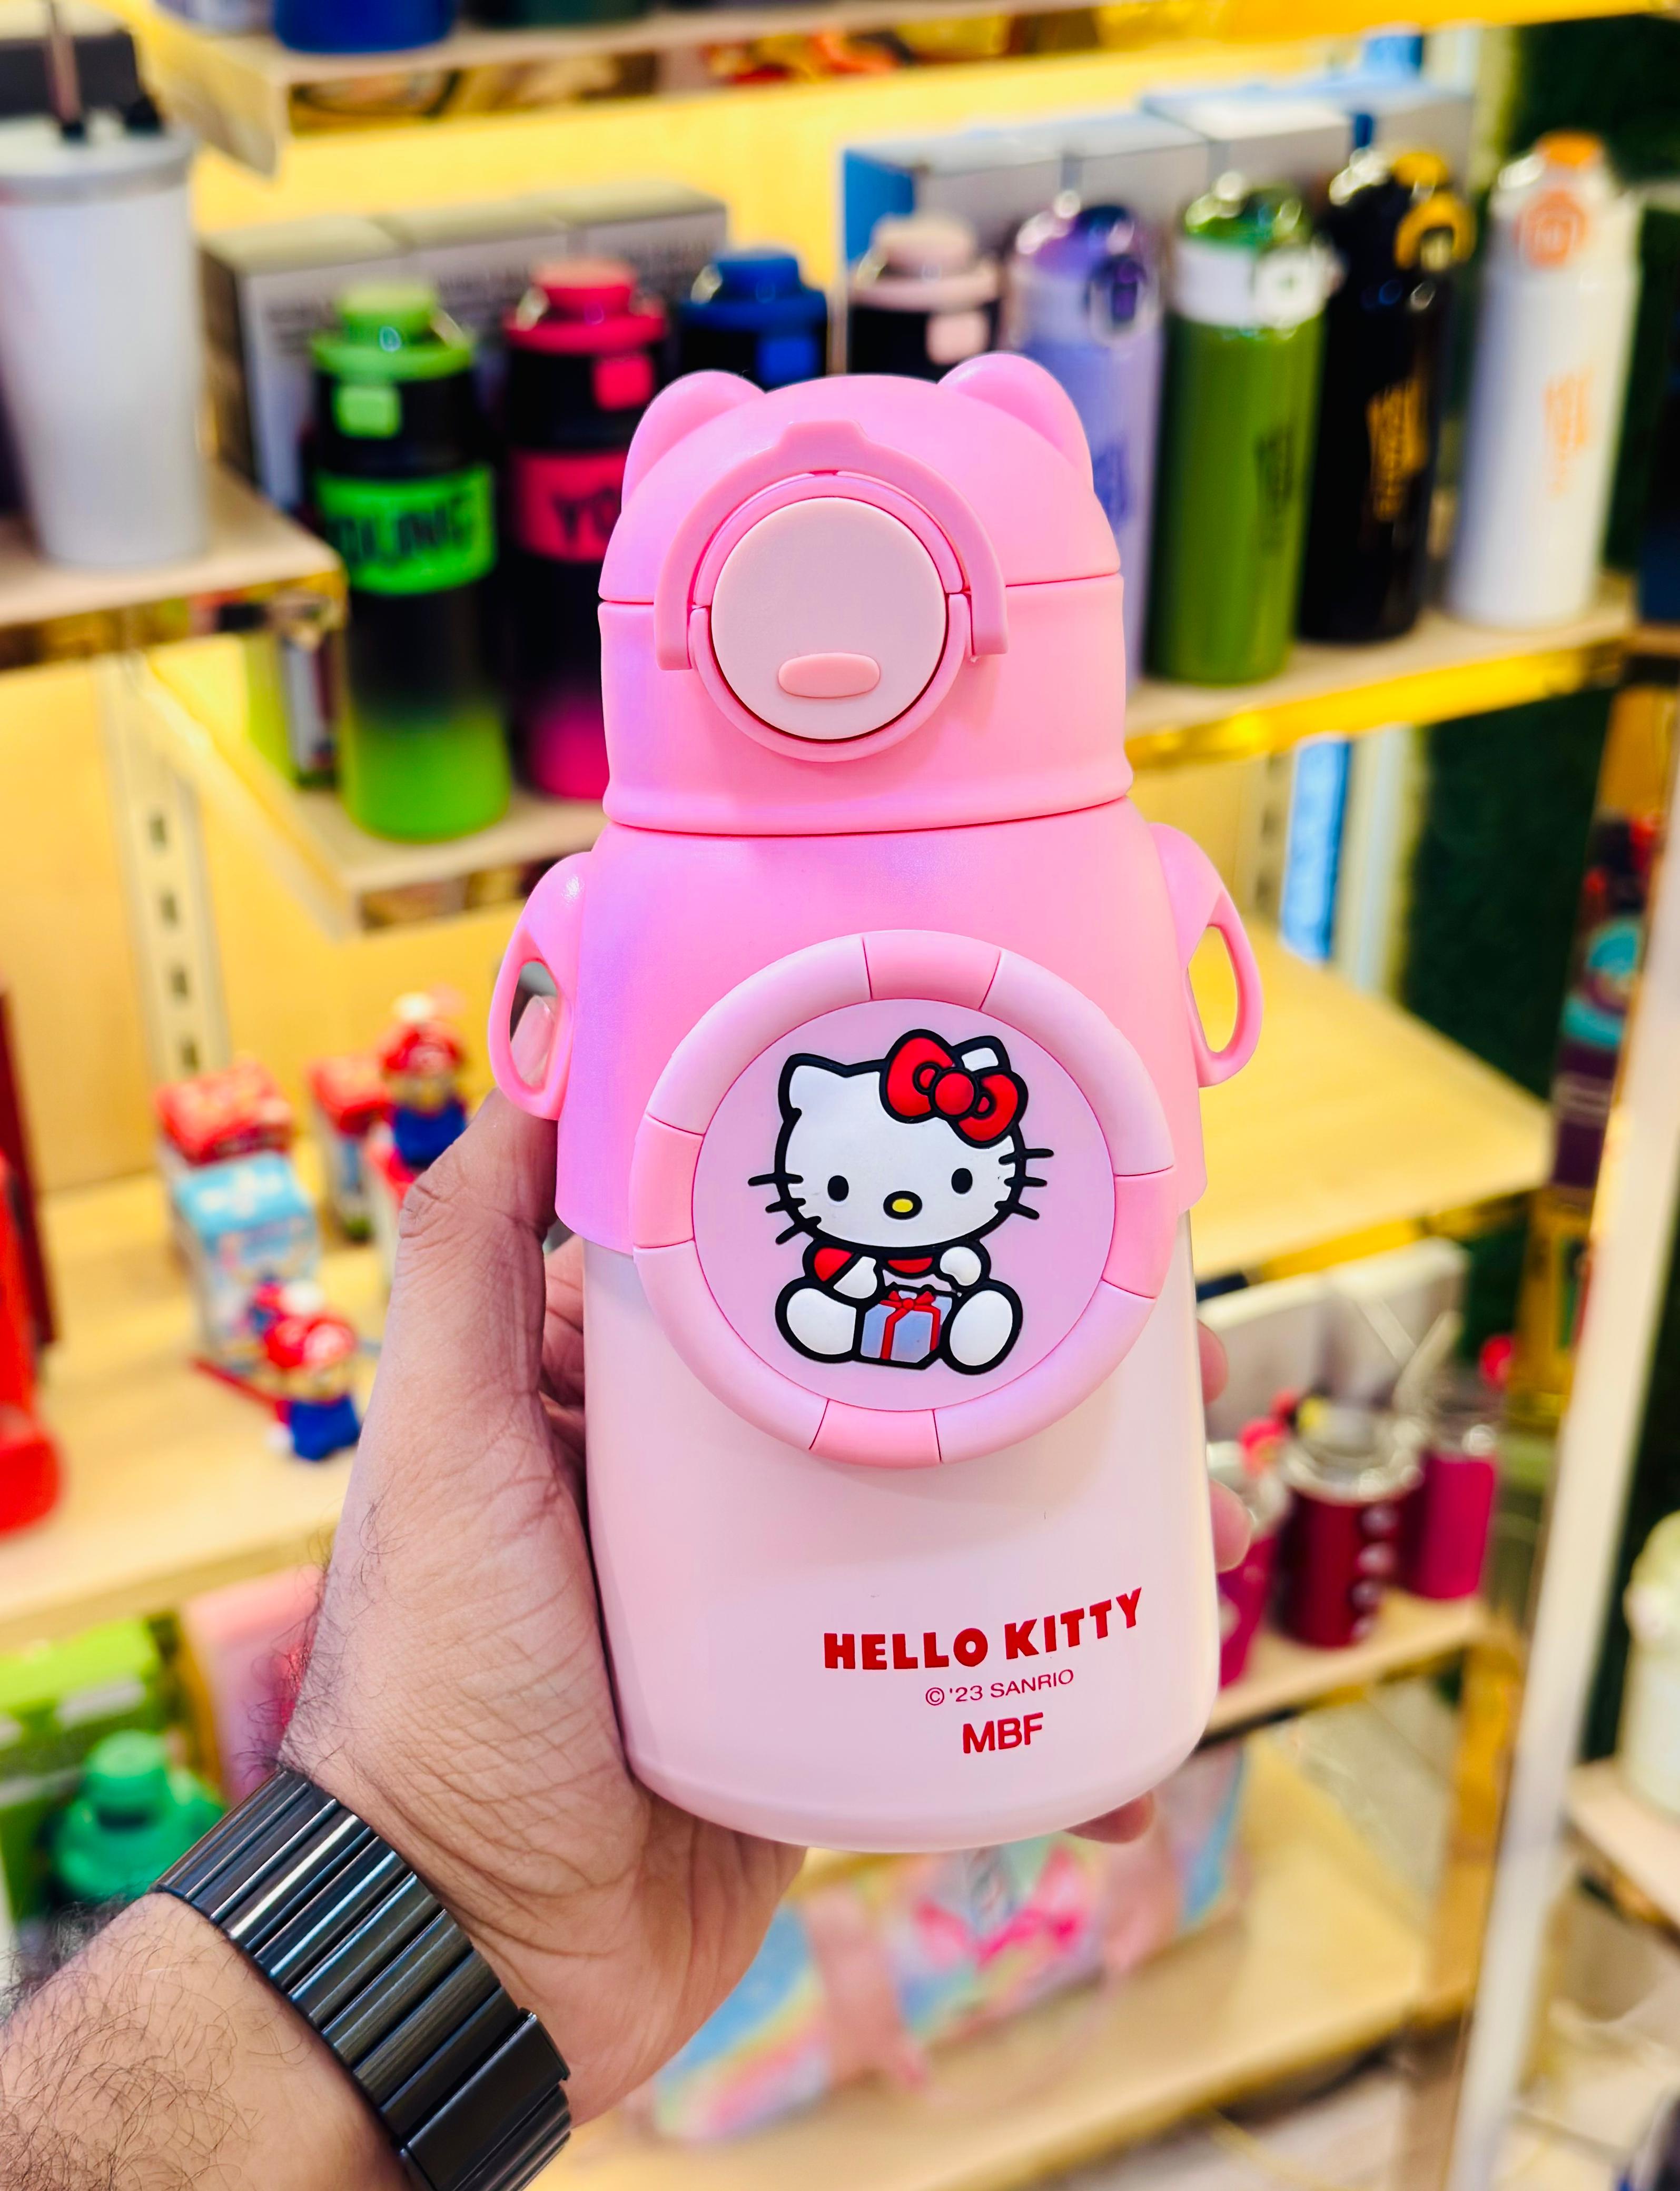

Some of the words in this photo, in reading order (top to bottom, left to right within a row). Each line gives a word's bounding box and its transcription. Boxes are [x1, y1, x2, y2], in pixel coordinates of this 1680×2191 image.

[823, 1627, 989, 1671] HELLO
[1004, 1586, 1142, 1661] KITTY
[990, 1669, 1075, 1699] SANRIO
[962, 1711, 1044, 1755] MBF
